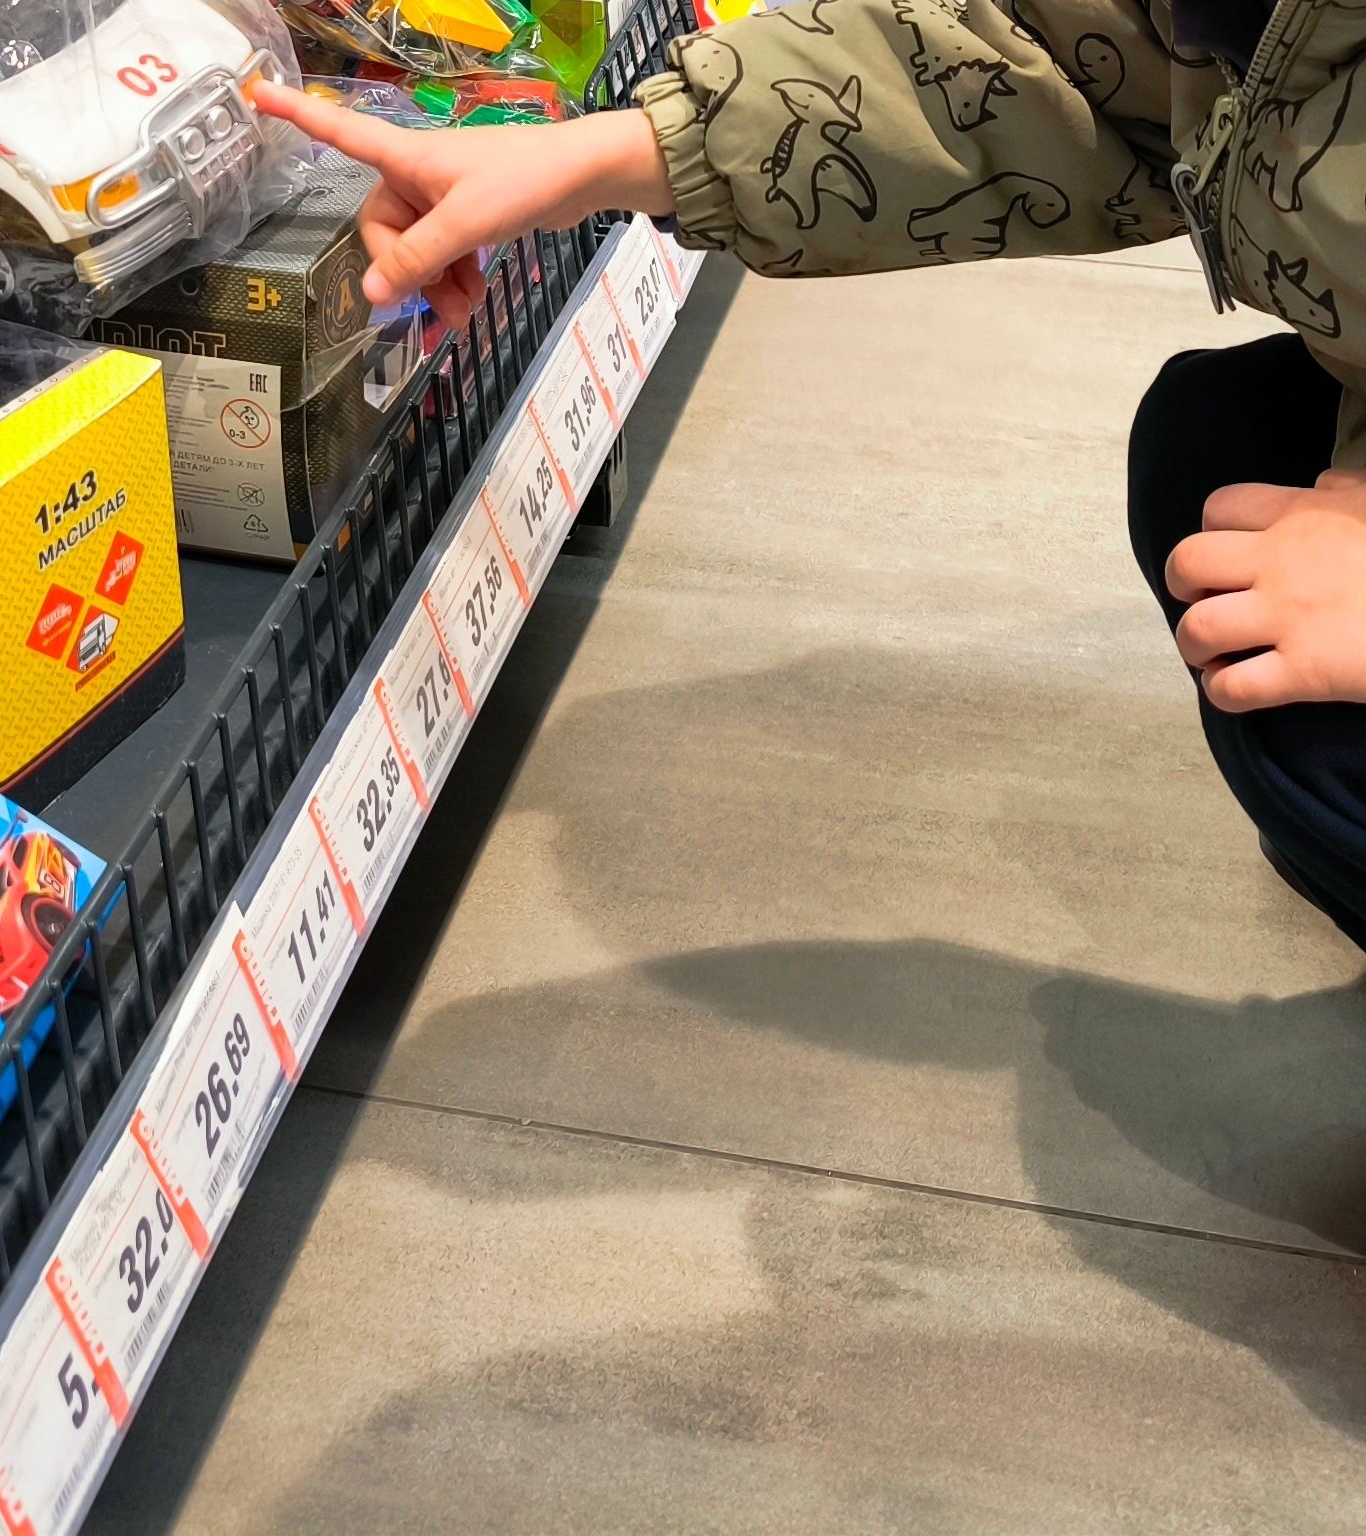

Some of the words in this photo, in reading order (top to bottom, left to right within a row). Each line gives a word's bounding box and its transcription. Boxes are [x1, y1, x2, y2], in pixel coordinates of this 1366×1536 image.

[116, 52, 179, 97] 03
[247, 277, 283, 313] 3+
[607, 322, 628, 373] 31
[228, 427, 247, 441] 0-3
[564, 374, 597, 452] 31,96
[33, 468, 99, 535] 1:43
[37, 489, 129, 571] МАСШТАБ
[519, 455, 554, 538] 14,25
[465, 554, 503, 647] 37,56
[288, 868, 335, 985] 11,41
[194, 1011, 254, 1161] 26,69
